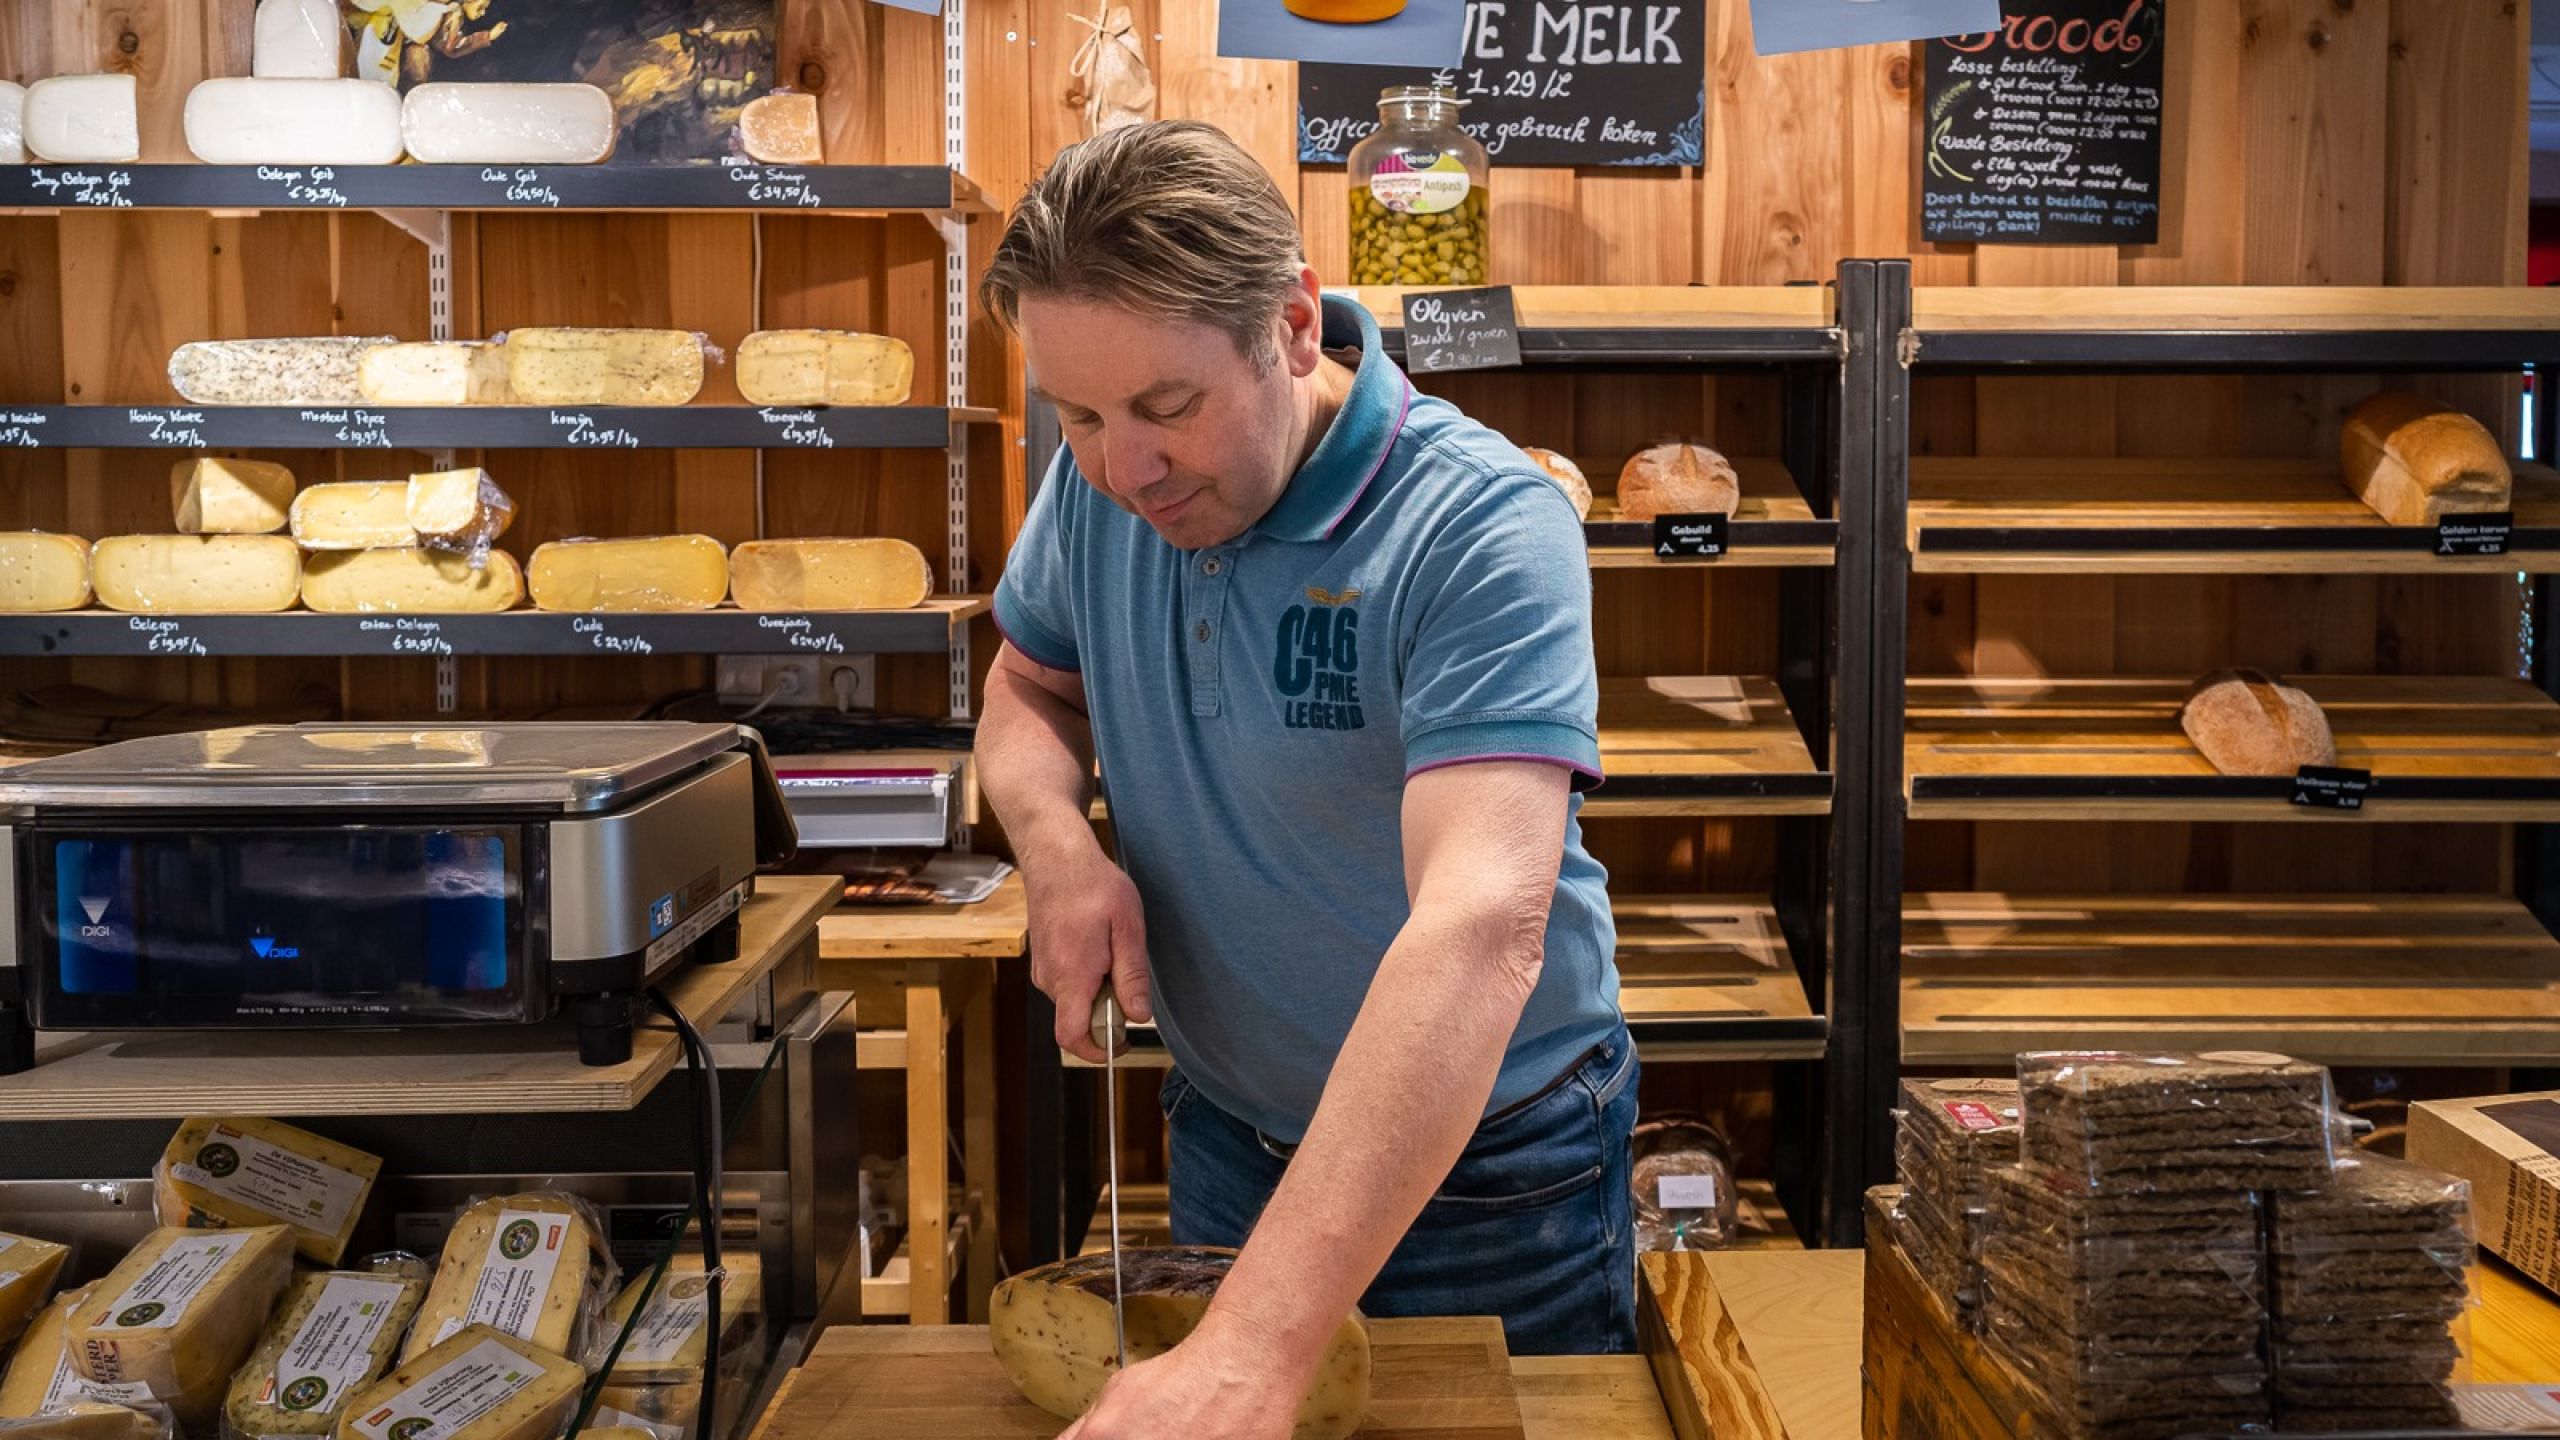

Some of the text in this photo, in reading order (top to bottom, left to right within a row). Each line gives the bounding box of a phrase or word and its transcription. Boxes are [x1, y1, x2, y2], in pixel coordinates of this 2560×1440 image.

[1526, 1, 1682, 65] MELK
[1941, 0, 2143, 52] rood
[1947, 56, 1993, 74] Losse
[1487, 117, 1589, 155] gebruik
[1600, 117, 1656, 145] koken
[1274, 604, 1358, 697] C46
[1314, 671, 1361, 703] PME
[1284, 700, 1366, 731] LEGEND
[82, 925, 110, 937] DIGI
[269, 947, 299, 958] DIGI
